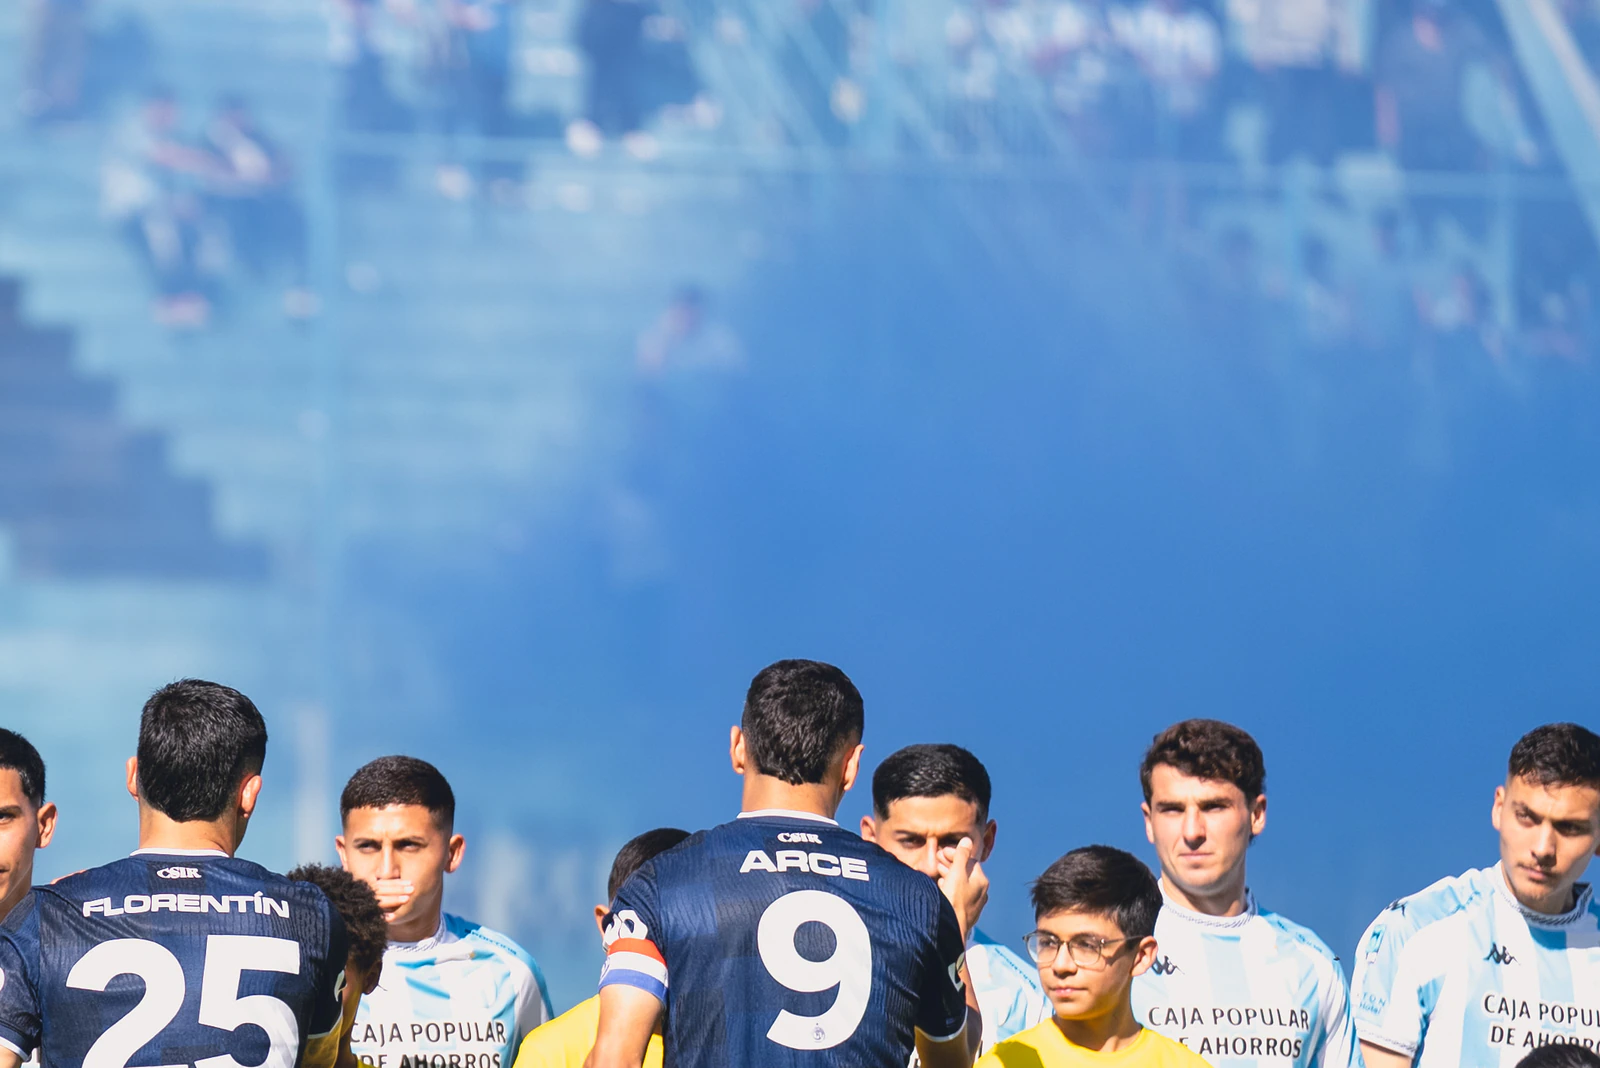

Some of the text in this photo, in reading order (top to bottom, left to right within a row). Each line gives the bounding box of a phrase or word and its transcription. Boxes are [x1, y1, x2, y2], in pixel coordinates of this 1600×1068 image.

[776, 831, 823, 845] CSIR
[156, 865, 202, 880] CSIR
[739, 849, 871, 882] ARCE
[82, 890, 290, 919] FLORENTÍN
[756, 889, 873, 1051] 9
[1148, 1006, 1310, 1031] CAJA POPULAR
[1483, 994, 1531, 1021] CAJA
[410, 1021, 507, 1045] POPULAR
[1491, 1025, 1516, 1046] DE
[1199, 1036, 1303, 1059] AHORROS
